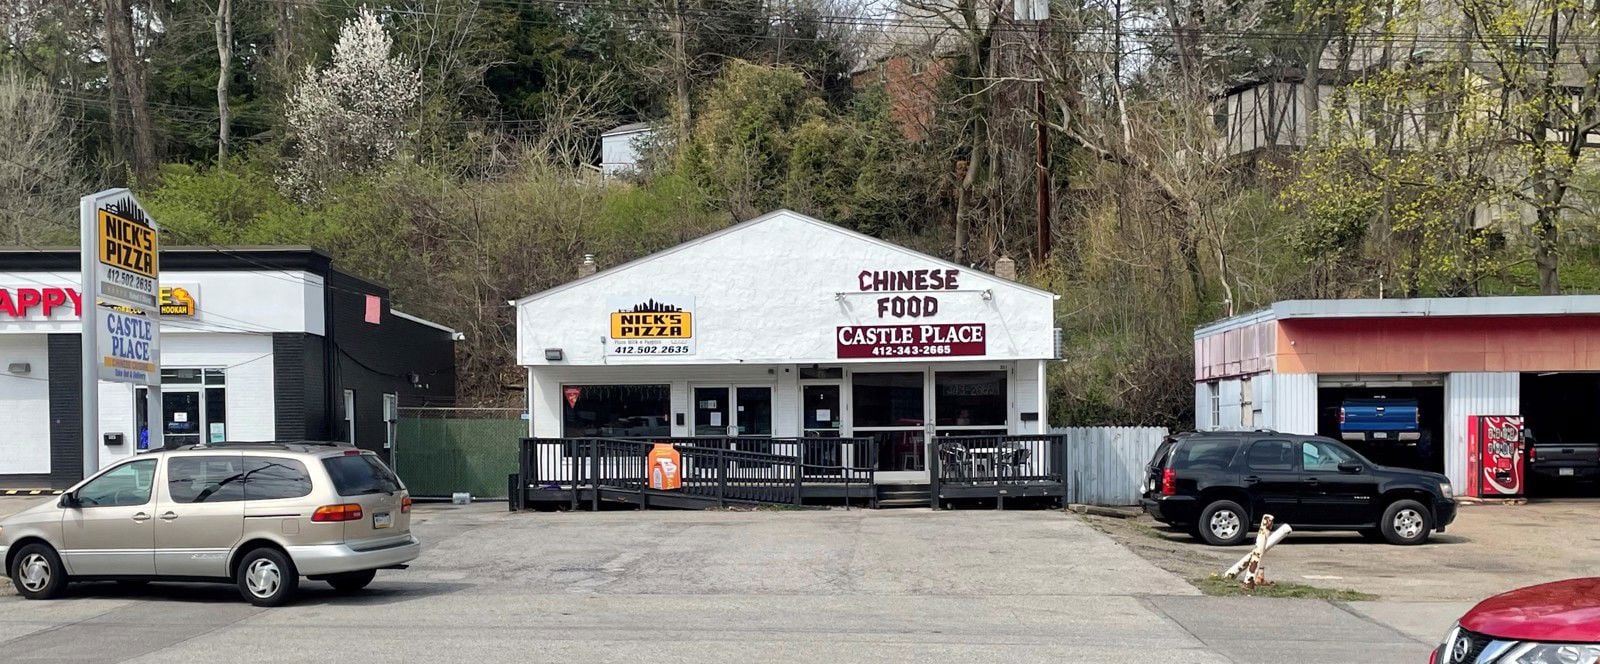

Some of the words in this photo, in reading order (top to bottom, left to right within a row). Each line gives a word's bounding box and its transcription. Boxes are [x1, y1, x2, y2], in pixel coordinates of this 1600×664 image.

[105, 215, 152, 252] NICK'S
[106, 239, 153, 274] PIZZA
[107, 268, 152, 292] 412.502.2635
[858, 269, 959, 291] CHINESE
[161, 306, 187, 314] HOOKAH
[877, 295, 938, 318] FOOD
[107, 313, 152, 341] CASTLE
[620, 314, 682, 325] NICK'S
[620, 326, 682, 336] PIZZA
[111, 336, 150, 361] PLACE
[614, 346, 689, 354] 412.502.2635
[872, 345, 951, 355] 412-343-2665
